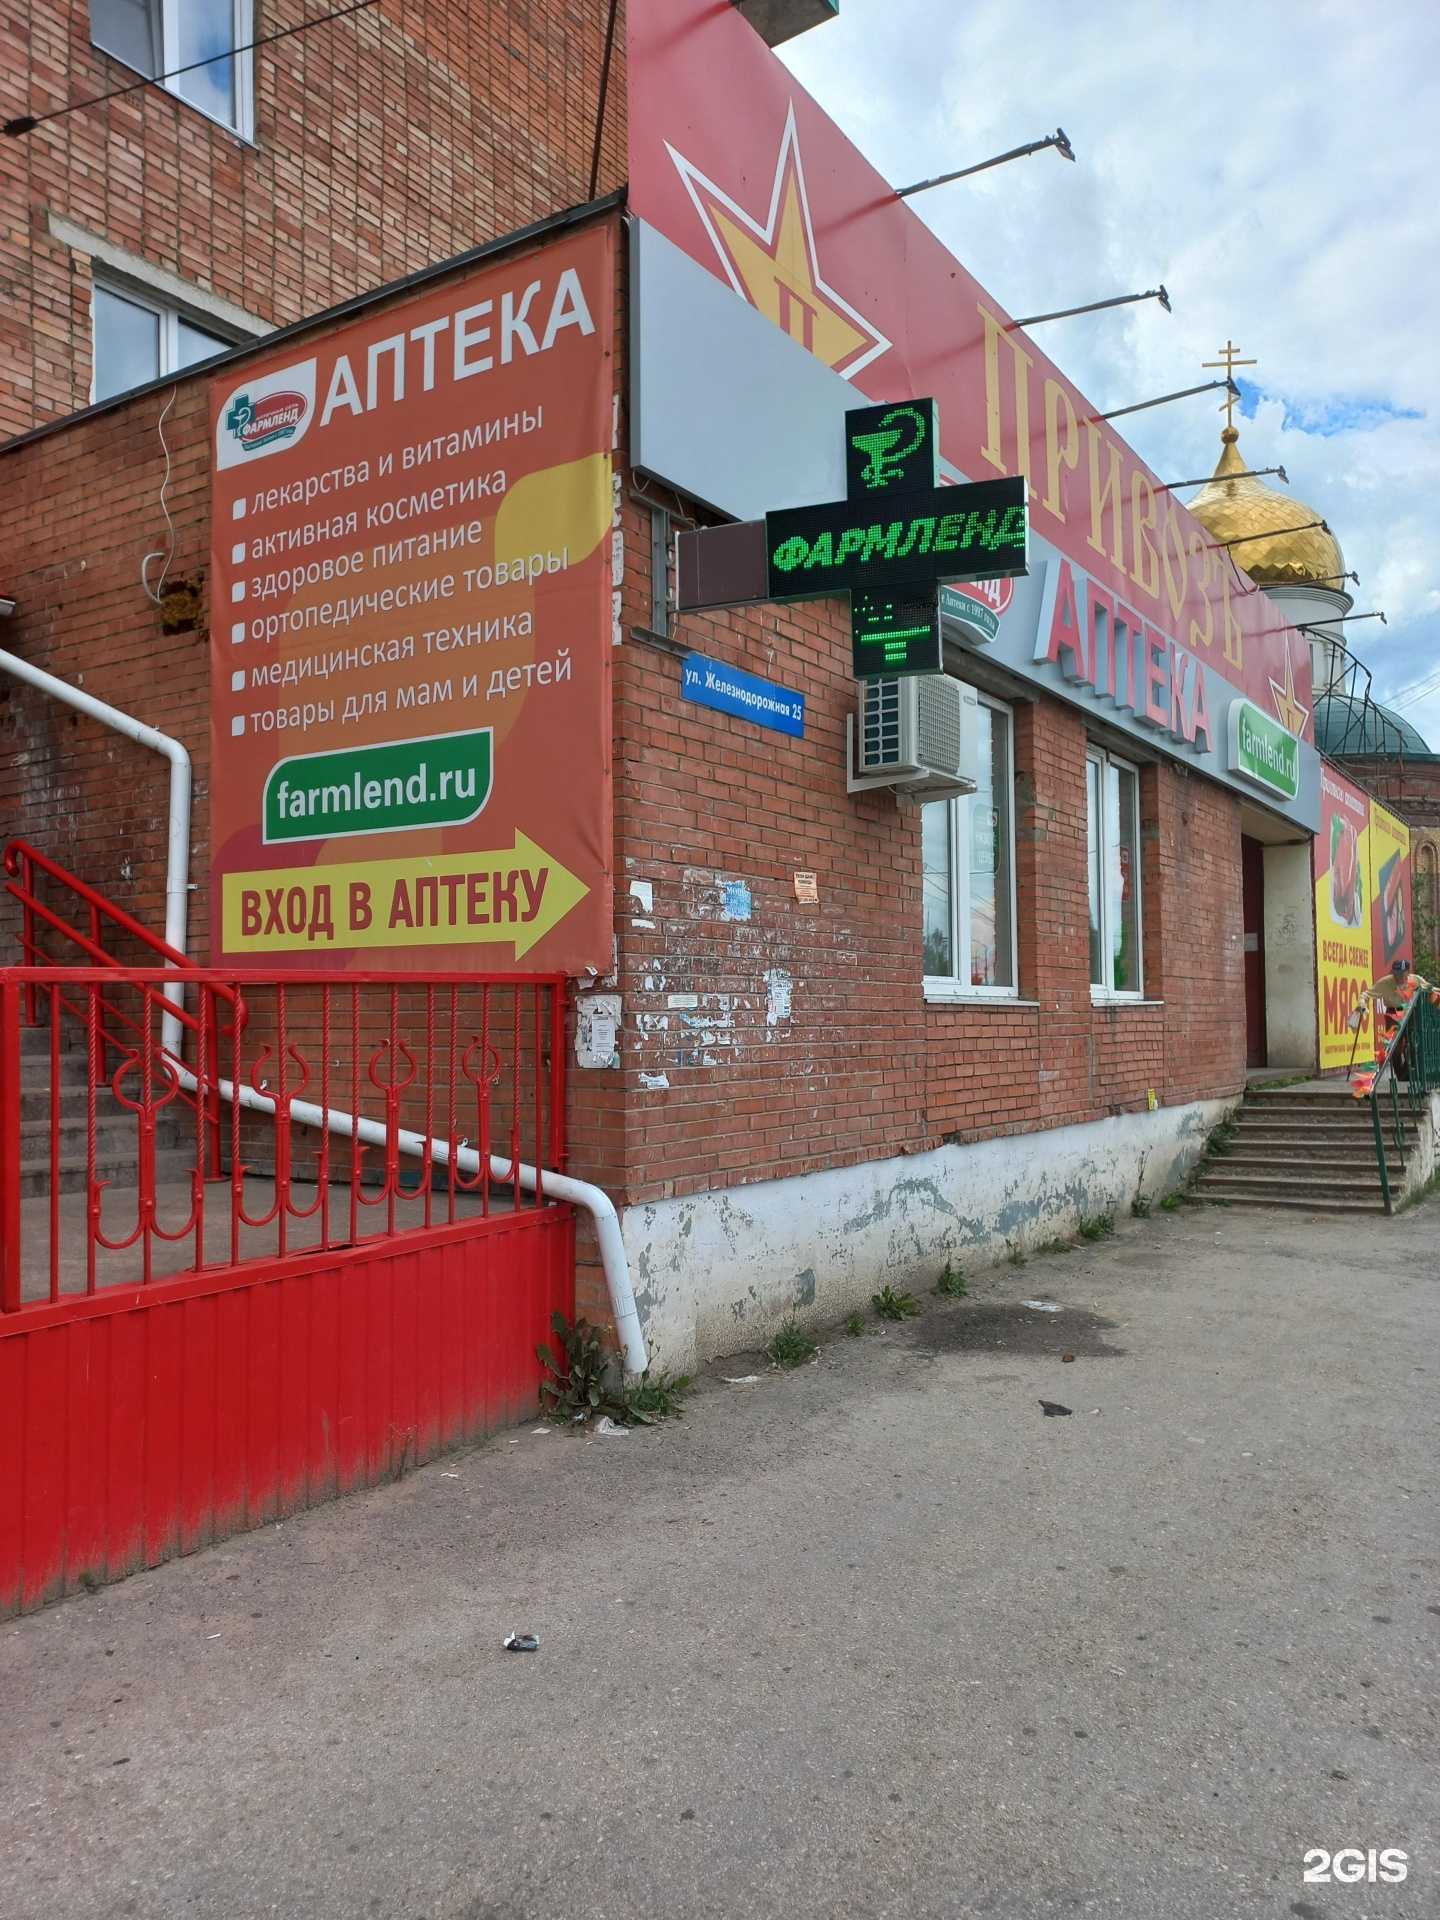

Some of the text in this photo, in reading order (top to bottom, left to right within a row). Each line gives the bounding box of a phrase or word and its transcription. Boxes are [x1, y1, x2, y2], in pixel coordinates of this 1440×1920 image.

[320, 268, 596, 427] АПТЕКА
[242, 407, 299, 437] ФАРМЛЕНД
[251, 405, 543, 516] лекарства и витамины
[251, 468, 507, 560] активная косметика
[977, 302, 1243, 671] ПРИВОЗЪ
[251, 520, 483, 601] здоровое питание
[773, 505, 1025, 572] ФАРМЛЕНД
[251, 573, 455, 643] ортопедические
[463, 546, 569, 593] товары
[251, 611, 533, 689] медицинская техника
[1038, 557, 1214, 754] АПТЕКА
[251, 648, 572, 734] товары для мам и детей
[685, 668, 802, 721] ул. Железнодорожная 25
[1242, 718, 1296, 782] farmlend.ru
[277, 763, 476, 819] farmlend.ru
[241, 867, 550, 942] ВХОД В АПТЕКУ
[1322, 940, 1347, 969] ВСЕГДА
